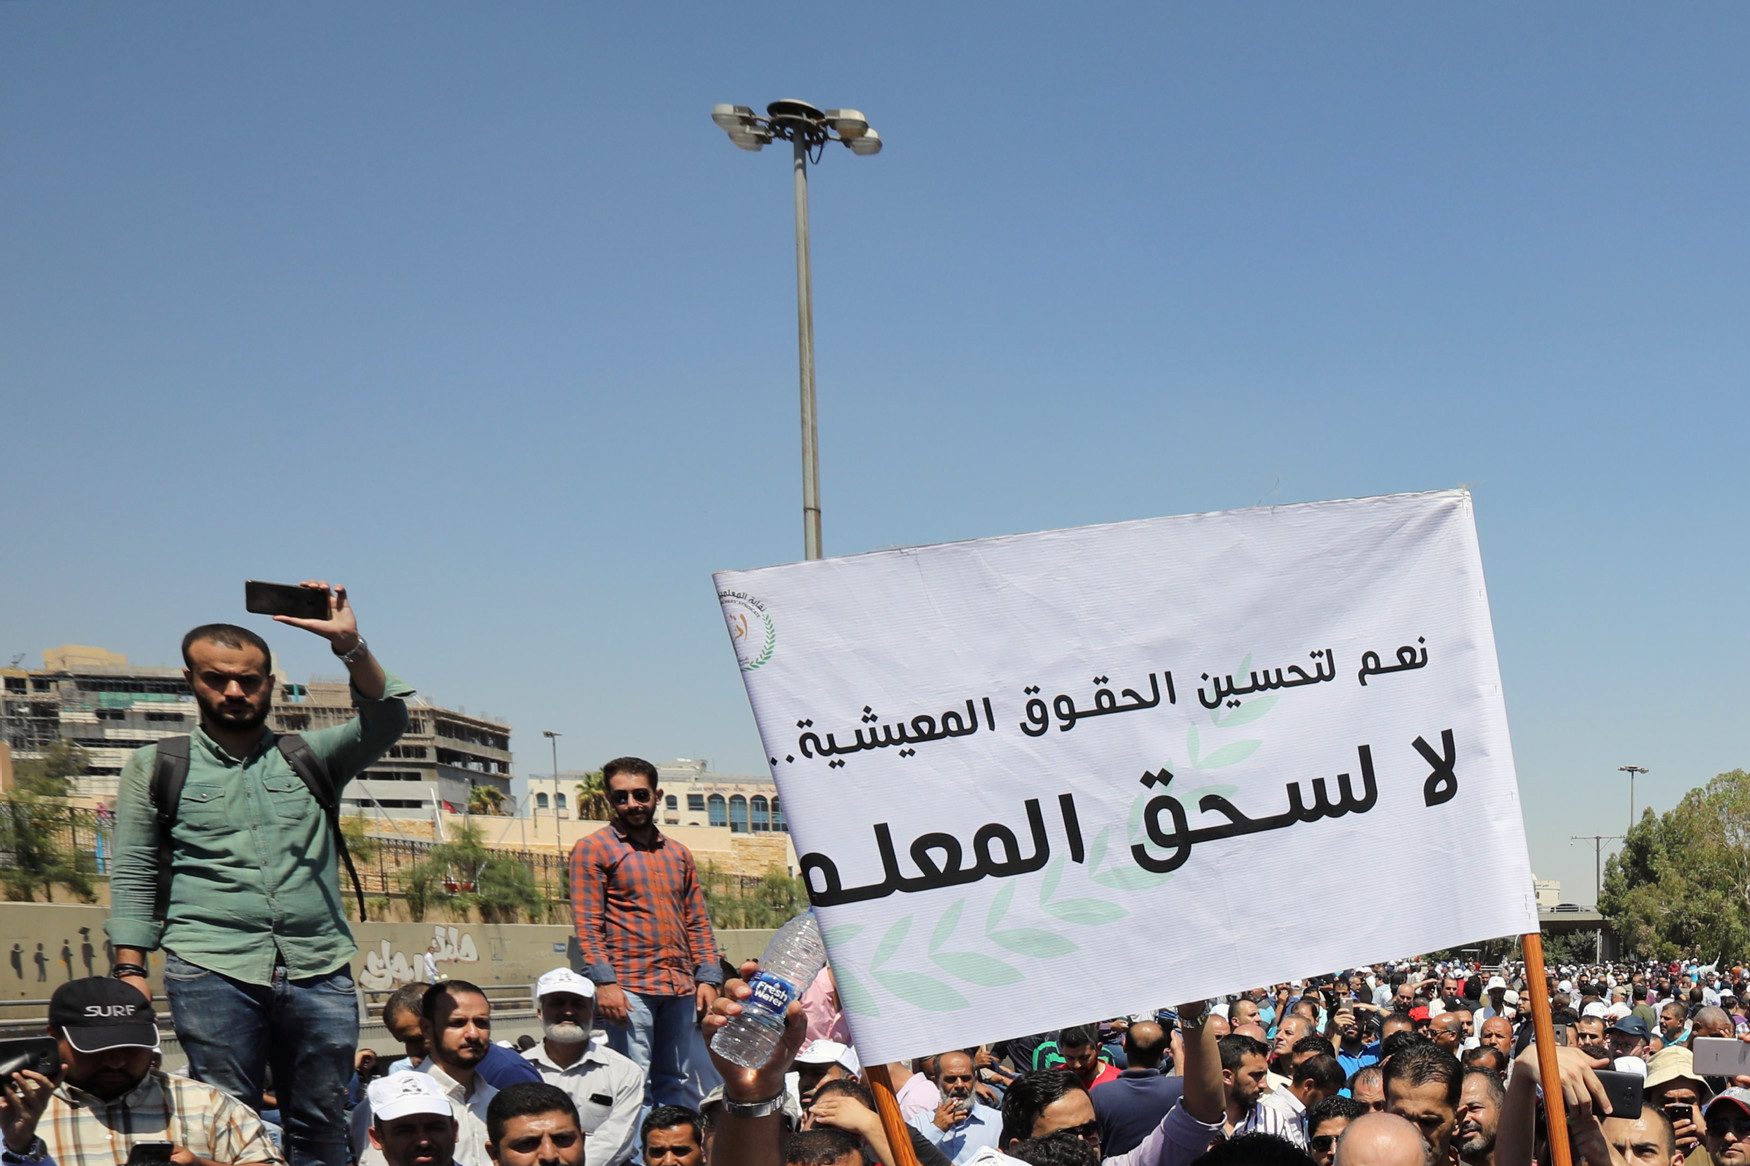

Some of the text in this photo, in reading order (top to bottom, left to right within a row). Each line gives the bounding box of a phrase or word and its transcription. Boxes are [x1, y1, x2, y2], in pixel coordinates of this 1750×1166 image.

[1197, 649, 1335, 710] لتحسين
[1358, 637, 1428, 686] نعم
[1019, 671, 1176, 738] الحقوق
[1411, 729, 1457, 807] لا
[1131, 745, 1378, 873] لسحق
[83, 1004, 136, 1017] SURF
[754, 989, 784, 1007] Water
[757, 980, 788, 1002] Fresh
